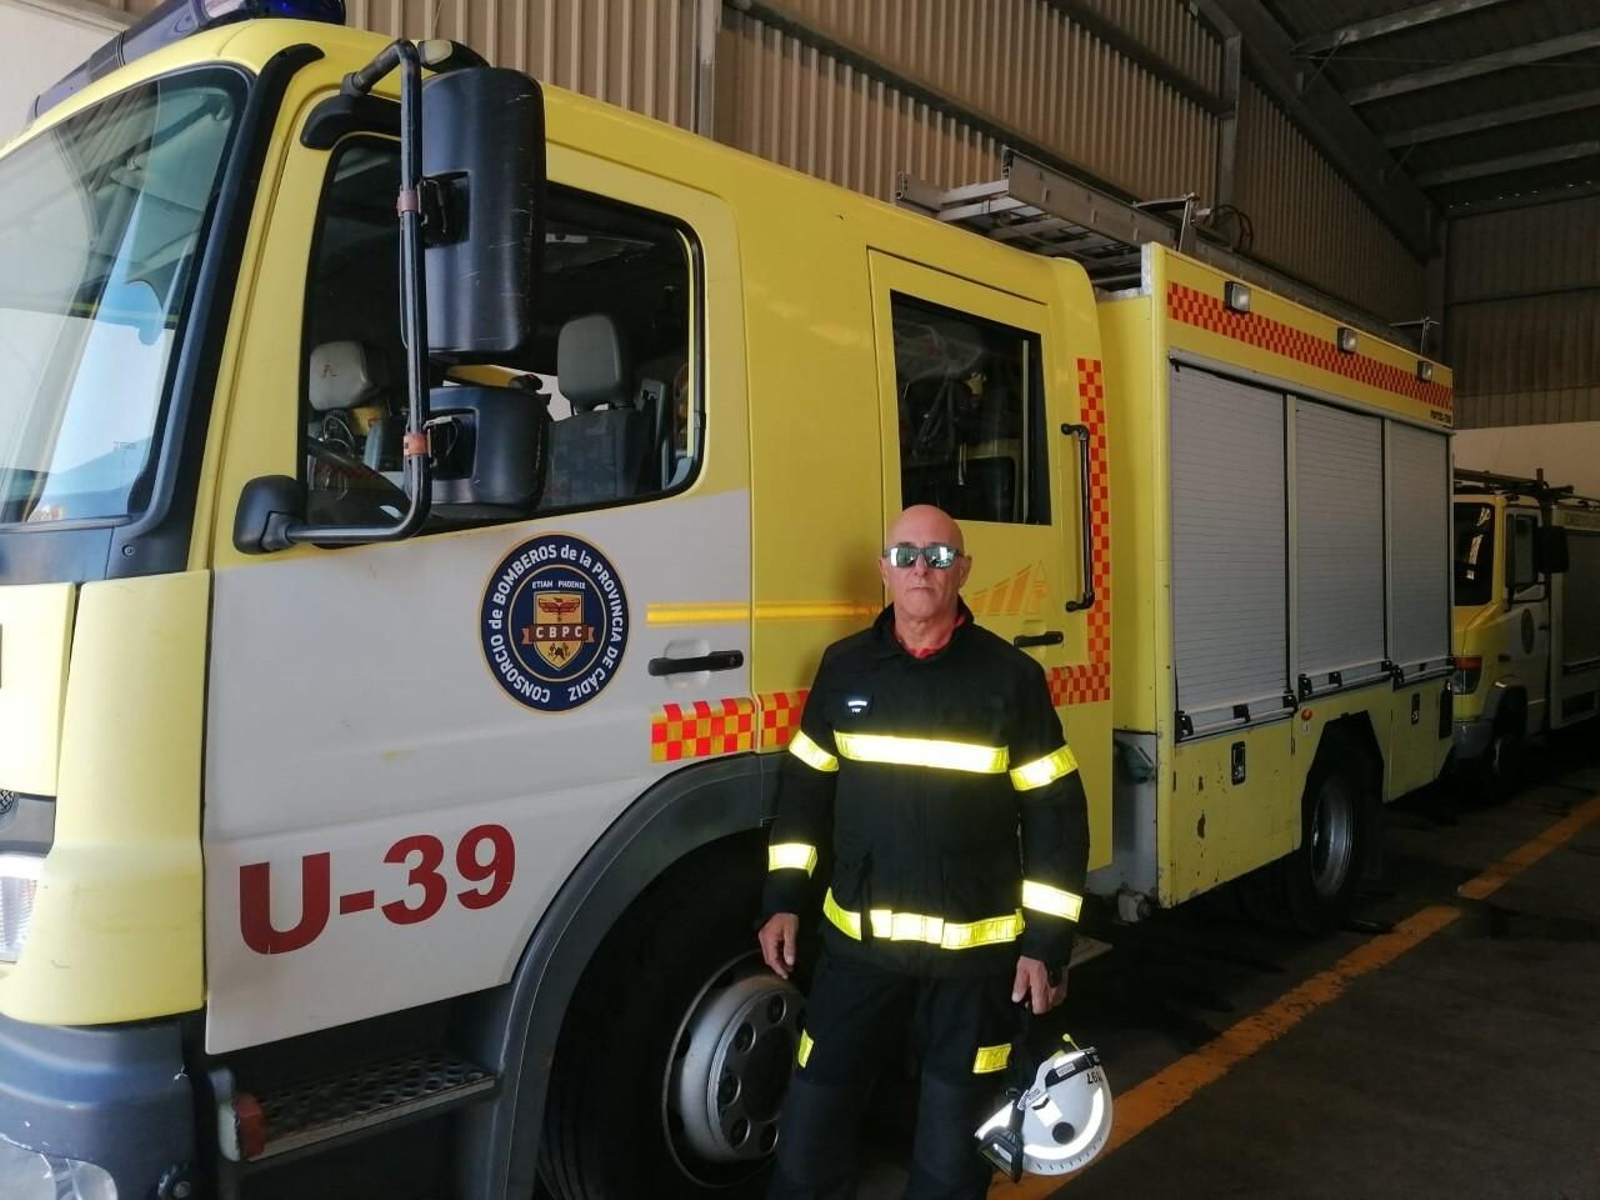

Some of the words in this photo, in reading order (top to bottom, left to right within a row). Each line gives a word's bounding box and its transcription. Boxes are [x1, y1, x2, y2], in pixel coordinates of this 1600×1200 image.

[560, 544, 578, 559] de
[579, 551, 592, 568] la
[492, 544, 556, 605] BOMBEROS
[532, 580, 553, 589] ETIAM
[558, 580, 586, 590] PHOENIX
[591, 562, 623, 642] PROVINCIA
[489, 609, 502, 629] de
[491, 634, 550, 703] CONSORCIO
[602, 648, 618, 669] DE
[568, 668, 606, 701] CÁDIZ
[239, 824, 516, 955] U-39
